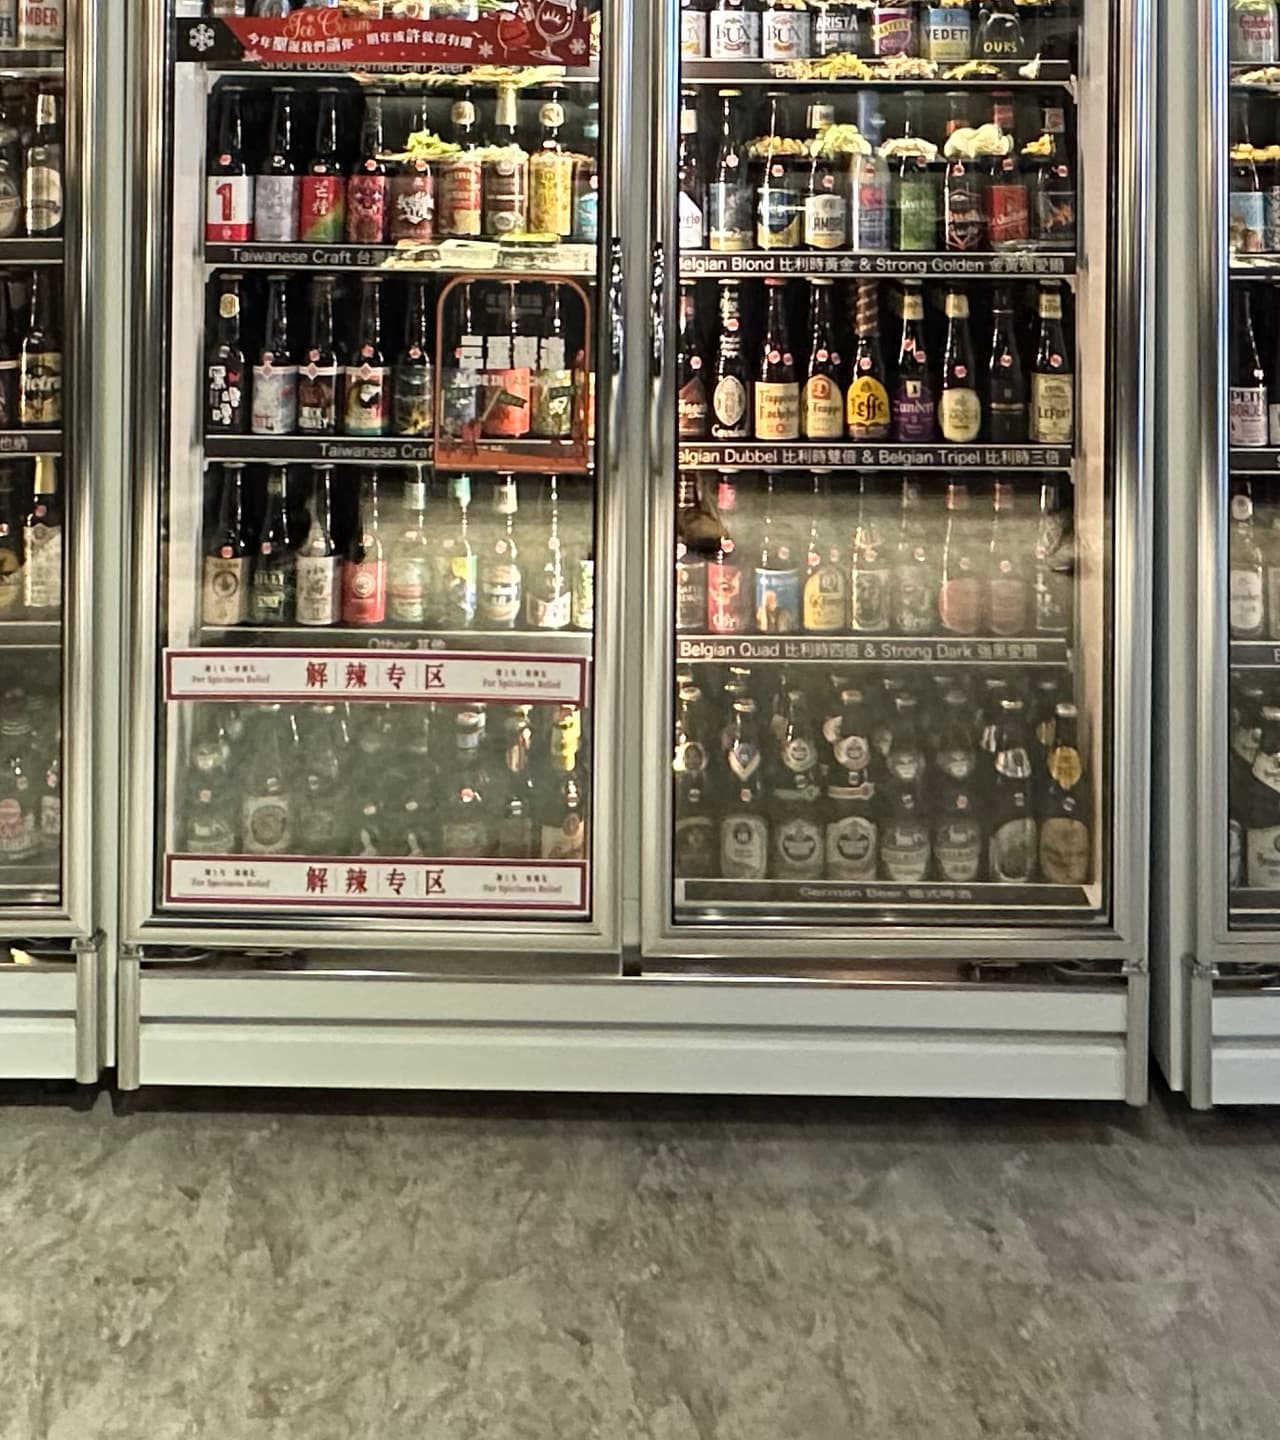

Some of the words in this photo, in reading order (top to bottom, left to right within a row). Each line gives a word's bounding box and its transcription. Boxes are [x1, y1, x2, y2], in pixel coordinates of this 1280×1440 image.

[216, 182, 232, 221] 1
[230, 248, 308, 263] Taiwanese
[312, 248, 352, 263] Craft
[731, 257, 775, 271] Blond
[779, 256, 855, 272] 比利時黃金
[859, 257, 871, 271] &
[876, 258, 927, 274] Strong
[931, 258, 984, 272] Golden
[320, 443, 397, 457] Taiwanese
[401, 444, 433, 458] Craf
[678, 449, 720, 466] elgian
[724, 449, 778, 464] Dubbel
[861, 450, 874, 464] &
[878, 450, 933, 466] Belgian
[938, 450, 981, 466] Tripel
[985, 450, 1060, 465] 比利時三倍
[680, 641, 735, 659] Belgian
[739, 642, 780, 657] Quad
[863, 644, 875, 658] &
[880, 643, 932, 660] Strong
[936, 643, 972, 658] Dark
